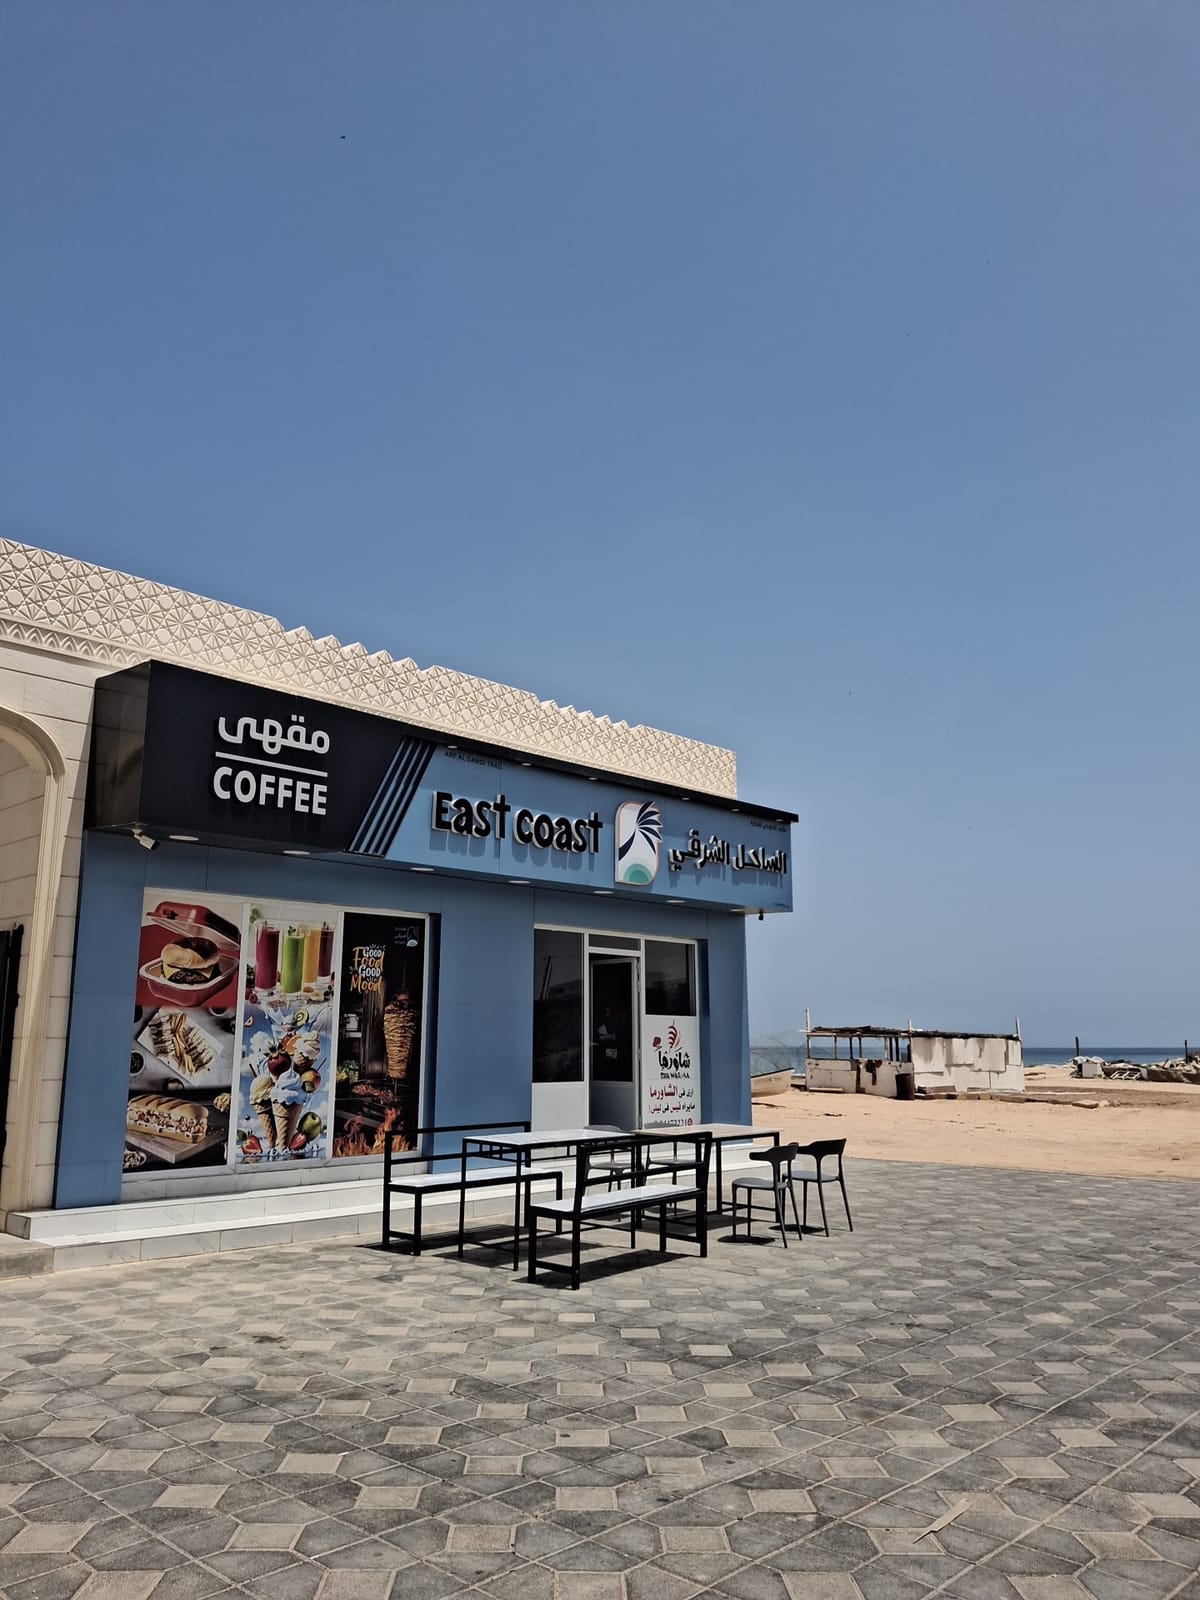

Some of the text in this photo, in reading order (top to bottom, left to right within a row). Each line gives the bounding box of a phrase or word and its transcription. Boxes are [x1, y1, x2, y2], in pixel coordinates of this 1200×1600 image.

[218, 714, 330, 755] مقهى
[213, 766, 328, 816] COFFEE
[431, 790, 511, 840] East
[668, 828, 787, 874] الساحل الشرقي
[352, 946, 385, 971] Food
[350, 974, 383, 994] Mood
[649, 1083, 678, 1100] الشاورما
